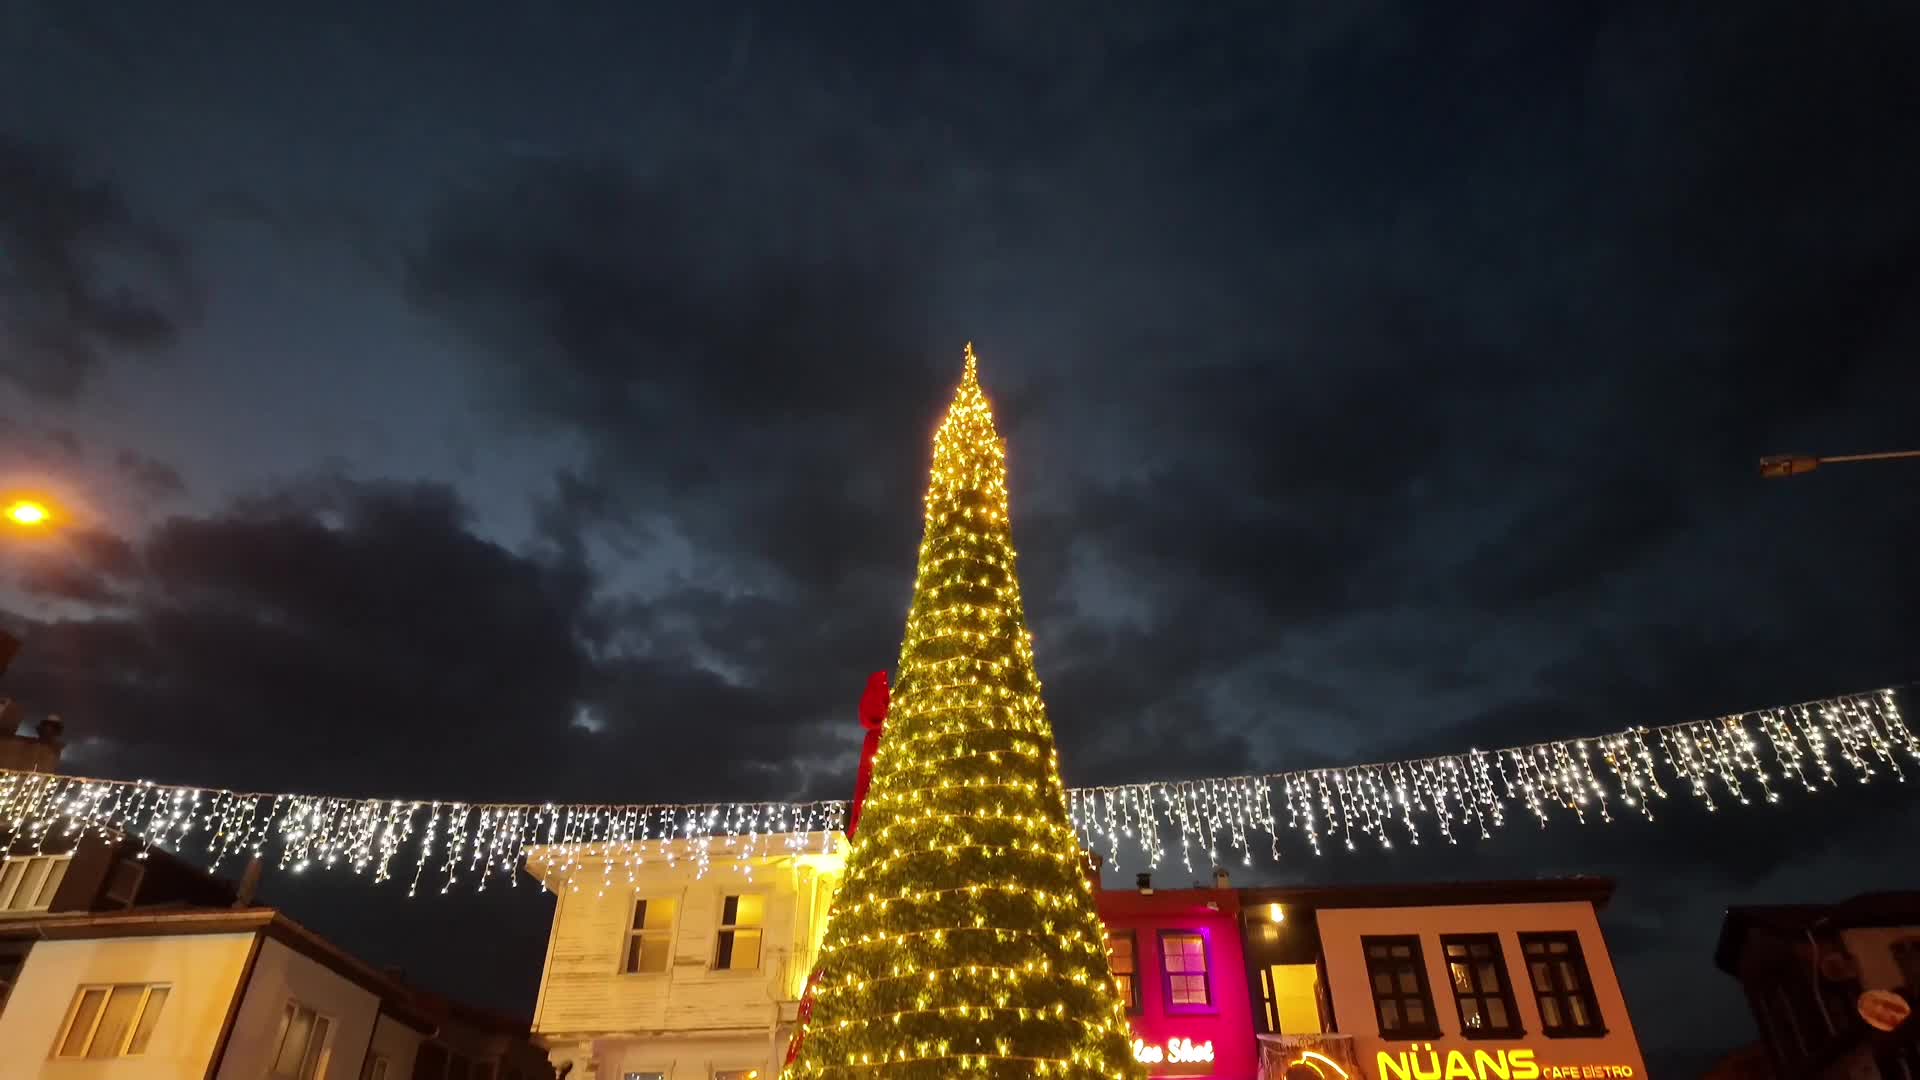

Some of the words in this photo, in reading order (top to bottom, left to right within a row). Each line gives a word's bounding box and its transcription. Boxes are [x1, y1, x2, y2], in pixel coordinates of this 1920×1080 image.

[1167, 1037, 1214, 1063] Shot
[1376, 1043, 1539, 1080] NÜANS
[1543, 1066, 1579, 1079] CAFE
